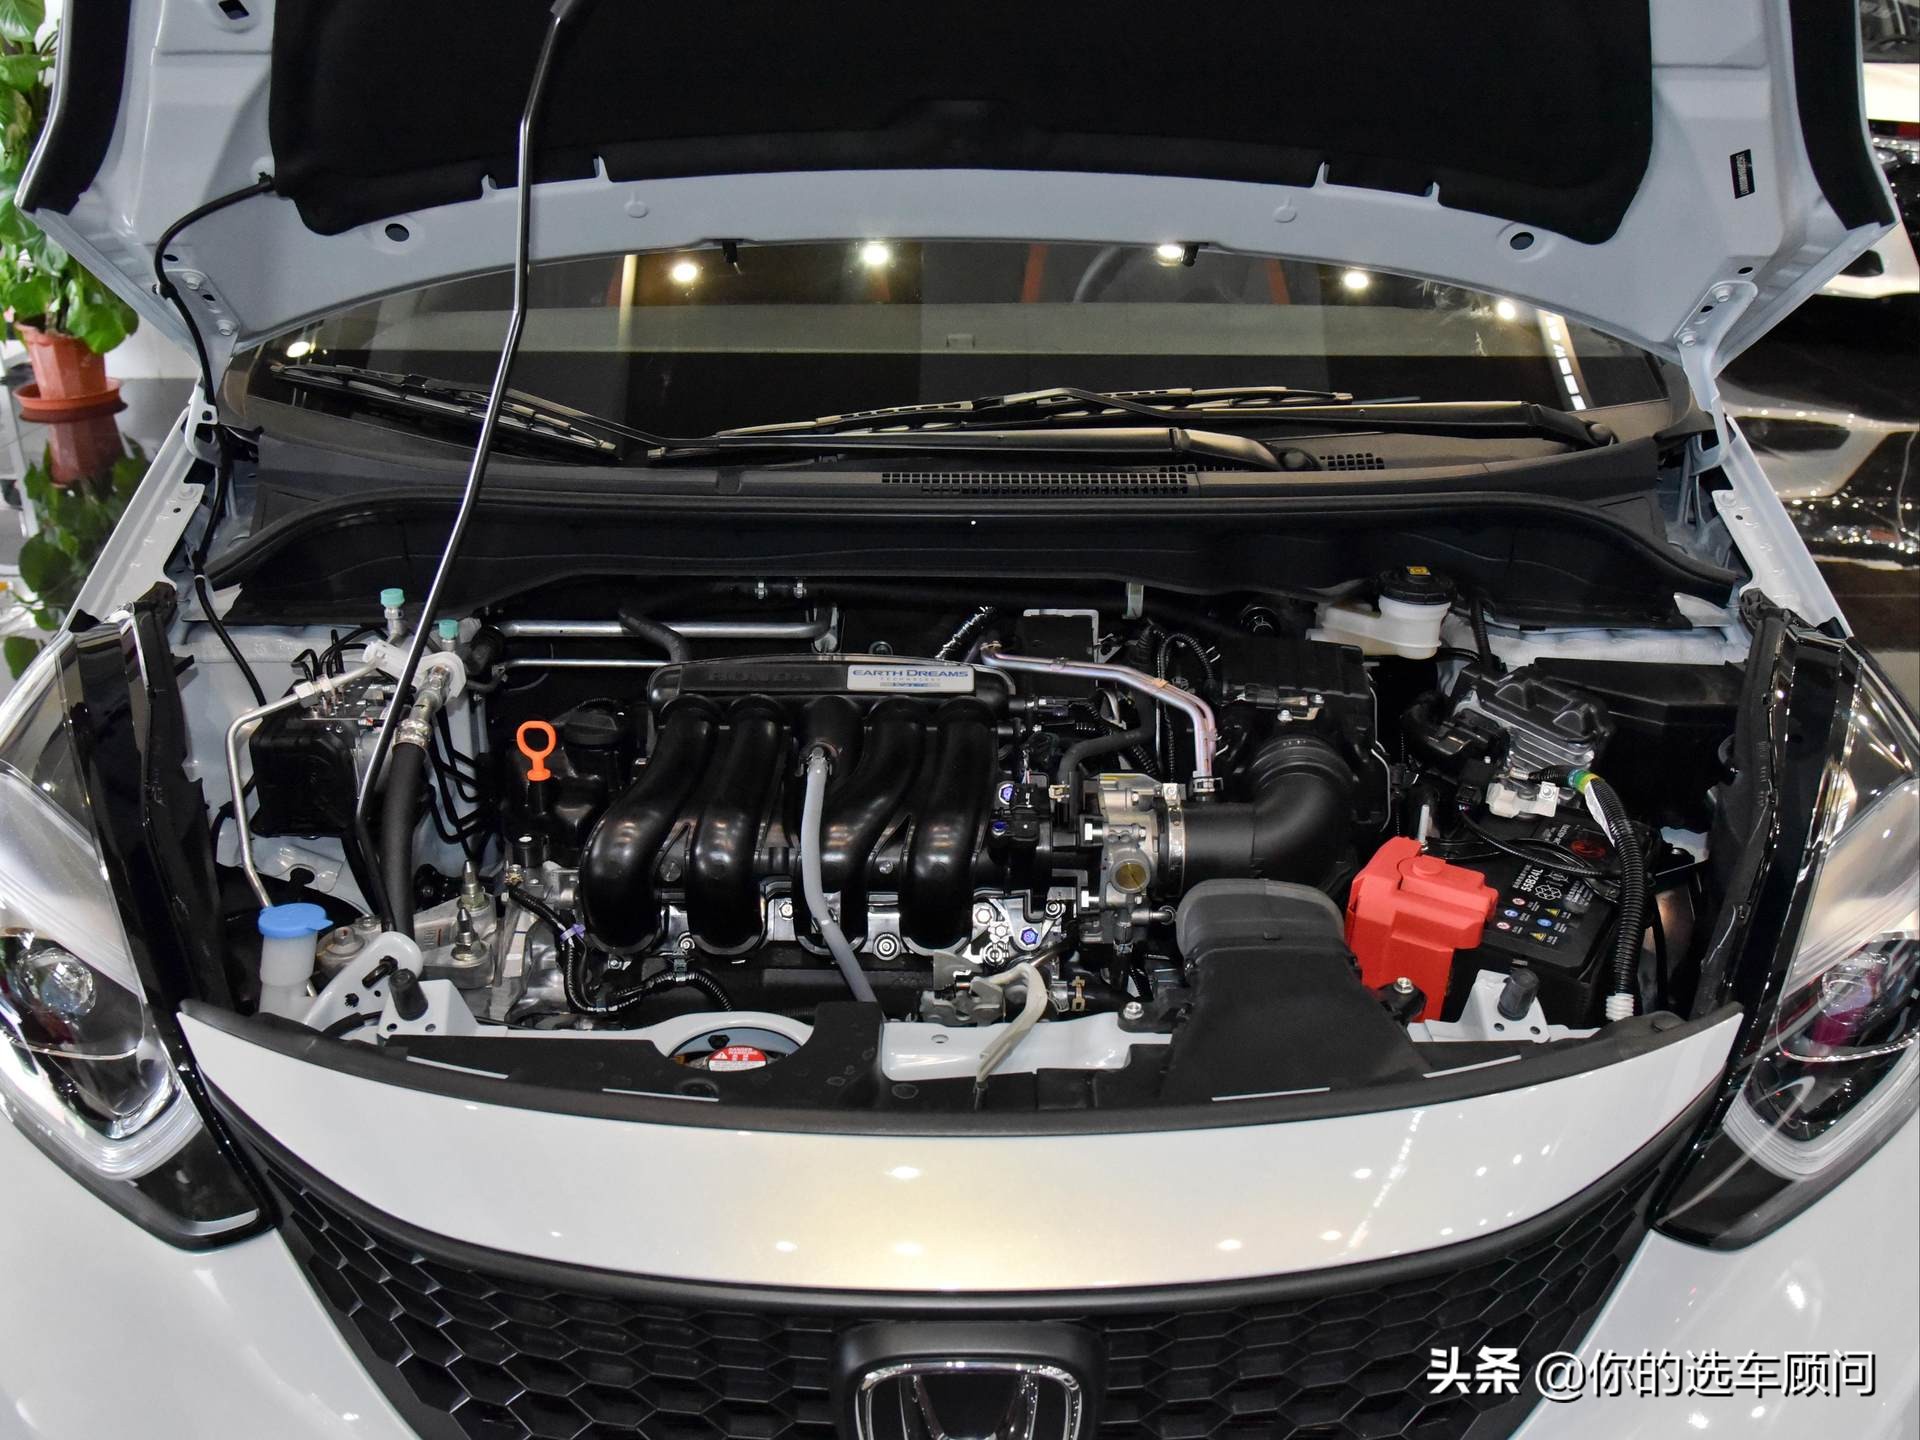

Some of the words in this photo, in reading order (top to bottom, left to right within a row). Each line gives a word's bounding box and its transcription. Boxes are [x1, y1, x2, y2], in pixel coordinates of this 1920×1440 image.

[852, 669, 903, 677] EARTH
[906, 669, 969, 677] DREAMS
[1520, 868, 1545, 893] 55B24L
